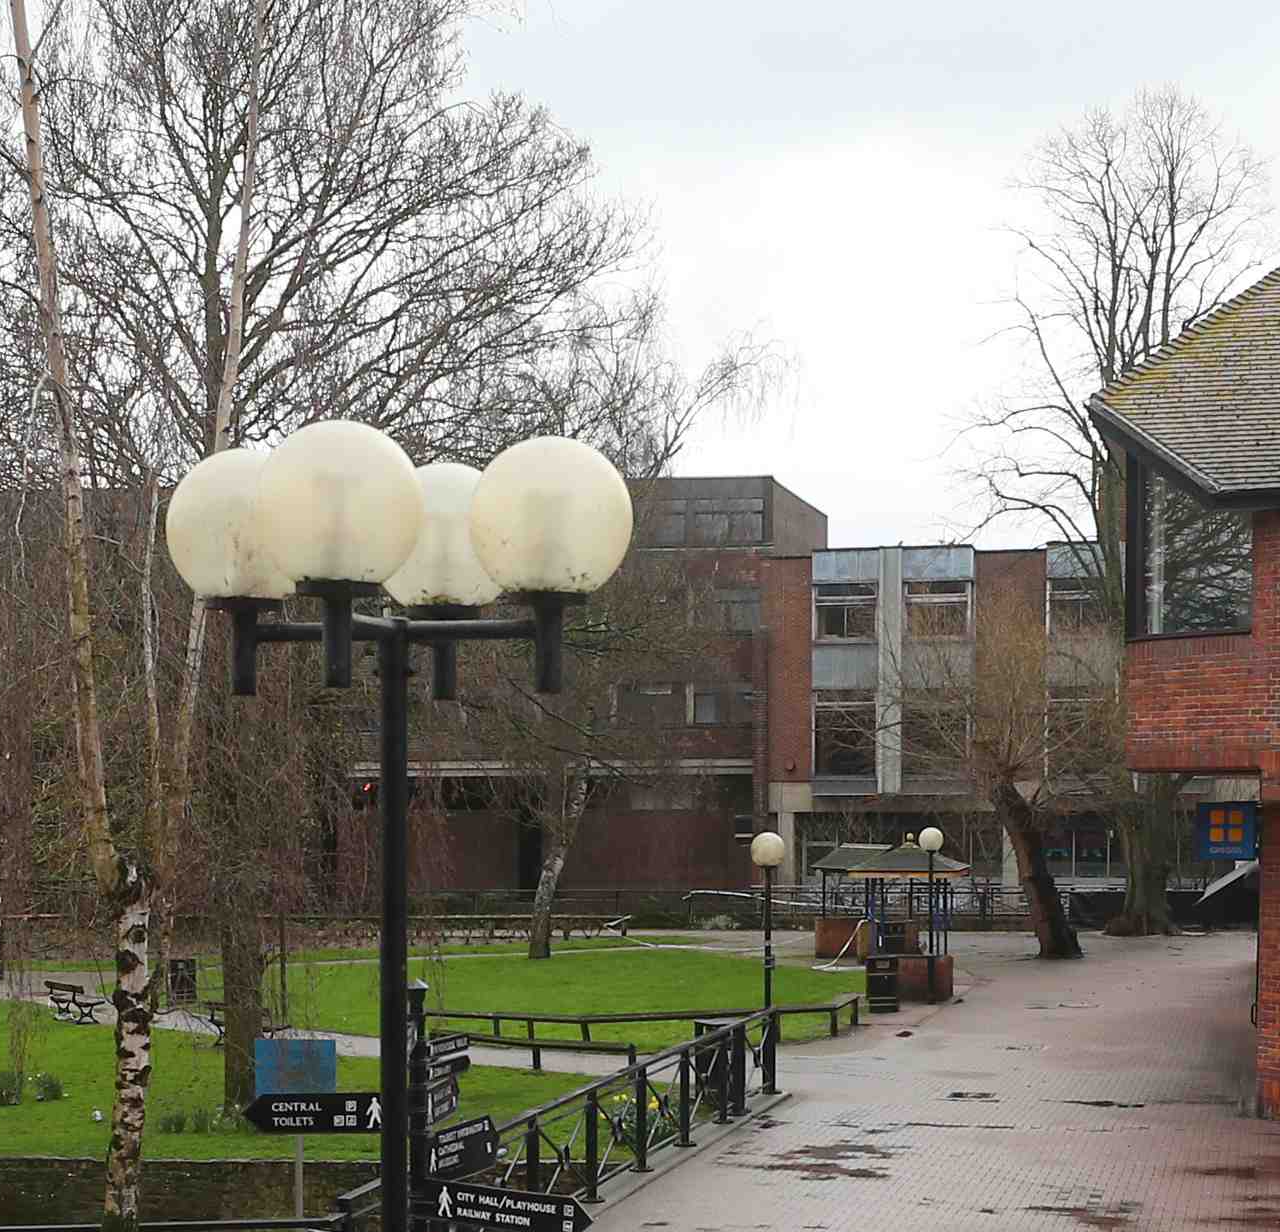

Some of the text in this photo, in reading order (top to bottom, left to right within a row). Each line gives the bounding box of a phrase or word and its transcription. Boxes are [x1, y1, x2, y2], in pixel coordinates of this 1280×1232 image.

[272, 1102, 322, 1113] CENTRAL
[272, 1117, 314, 1128] TOILETS
[457, 1192, 557, 1214] CITY HALL/PLAYHOUSE
[457, 1207, 530, 1226] RAILWAY STATION
